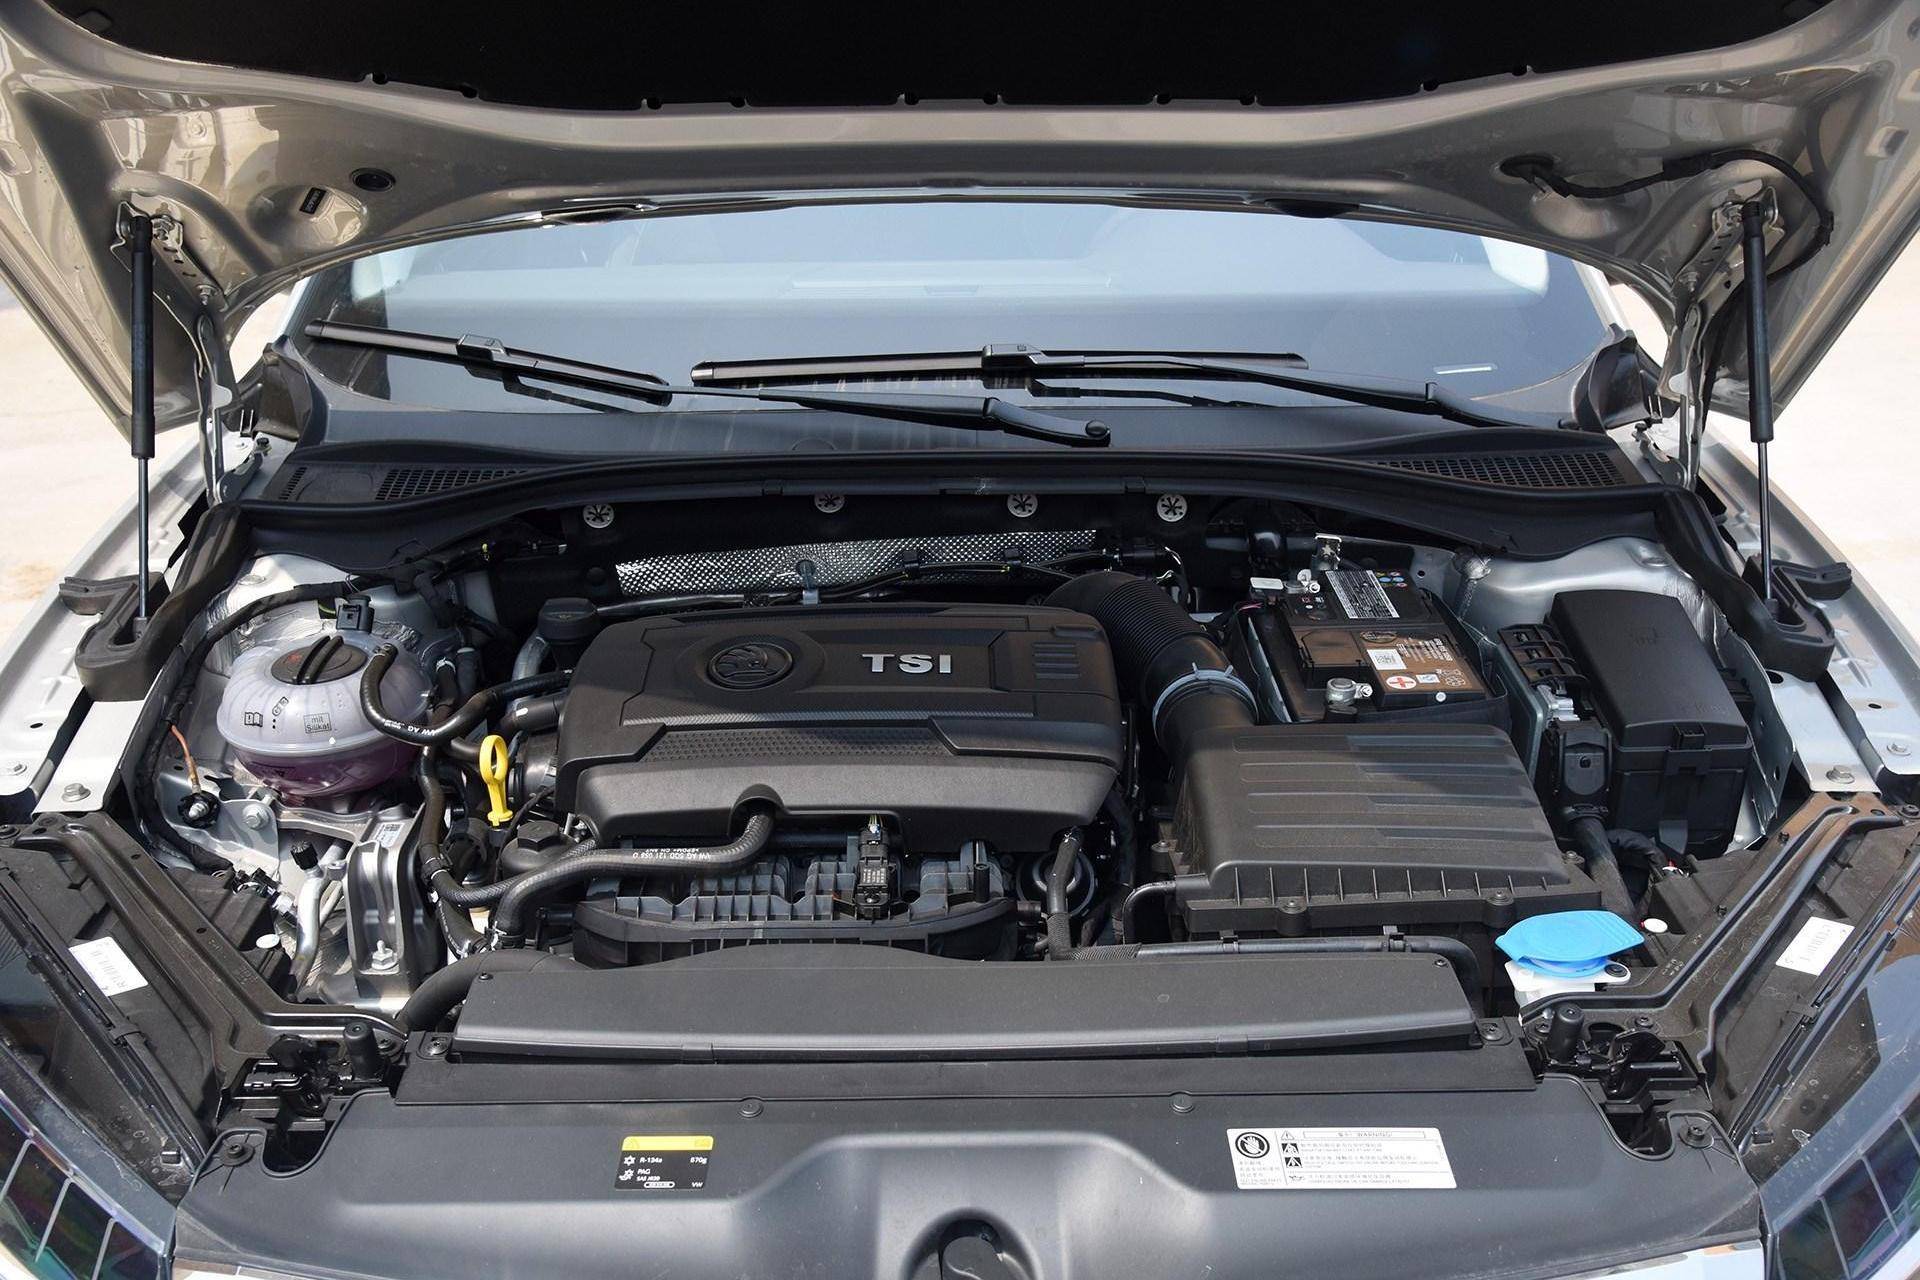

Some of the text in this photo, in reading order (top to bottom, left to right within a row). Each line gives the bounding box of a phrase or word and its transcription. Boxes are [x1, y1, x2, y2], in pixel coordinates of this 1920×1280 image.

[862, 653, 951, 674] TSI
[311, 714, 324, 724] mit
[306, 722, 330, 732] Silikat
